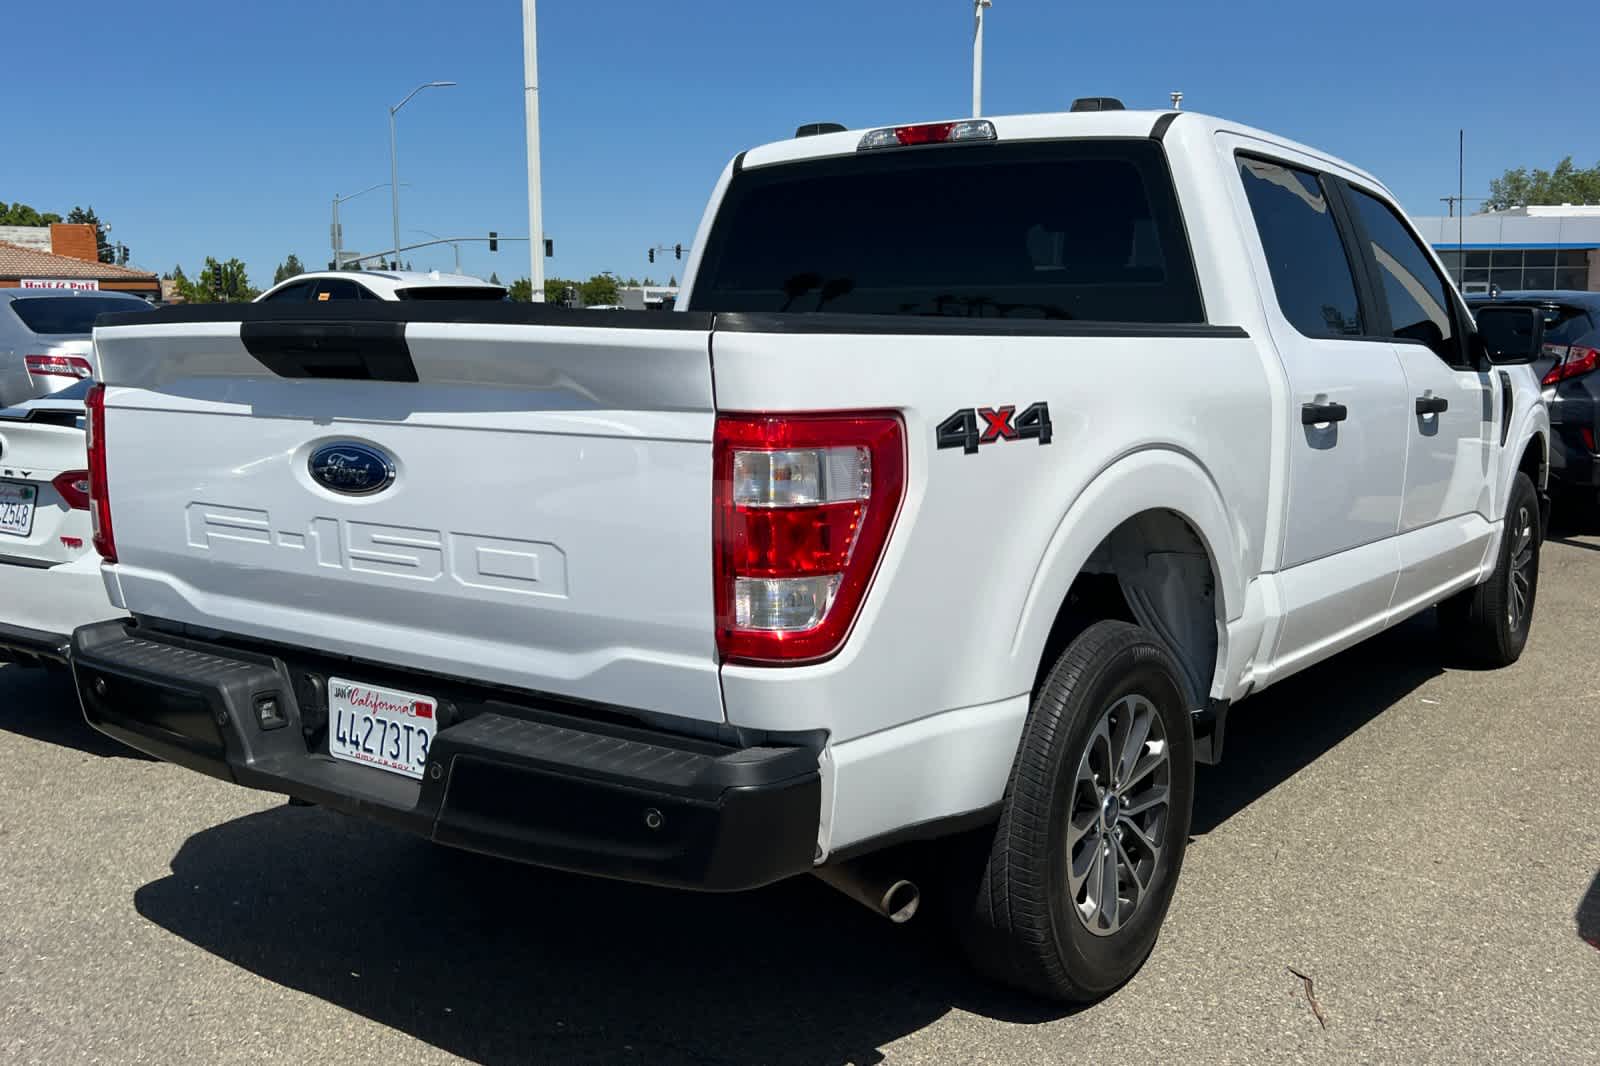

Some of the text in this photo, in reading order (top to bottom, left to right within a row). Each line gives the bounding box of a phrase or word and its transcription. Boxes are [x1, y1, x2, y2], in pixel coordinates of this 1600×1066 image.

[319, 452, 370, 485] Ford
[184, 500, 570, 599] F-150
[350, 687, 409, 716] California
[335, 710, 430, 767] 44273T3
